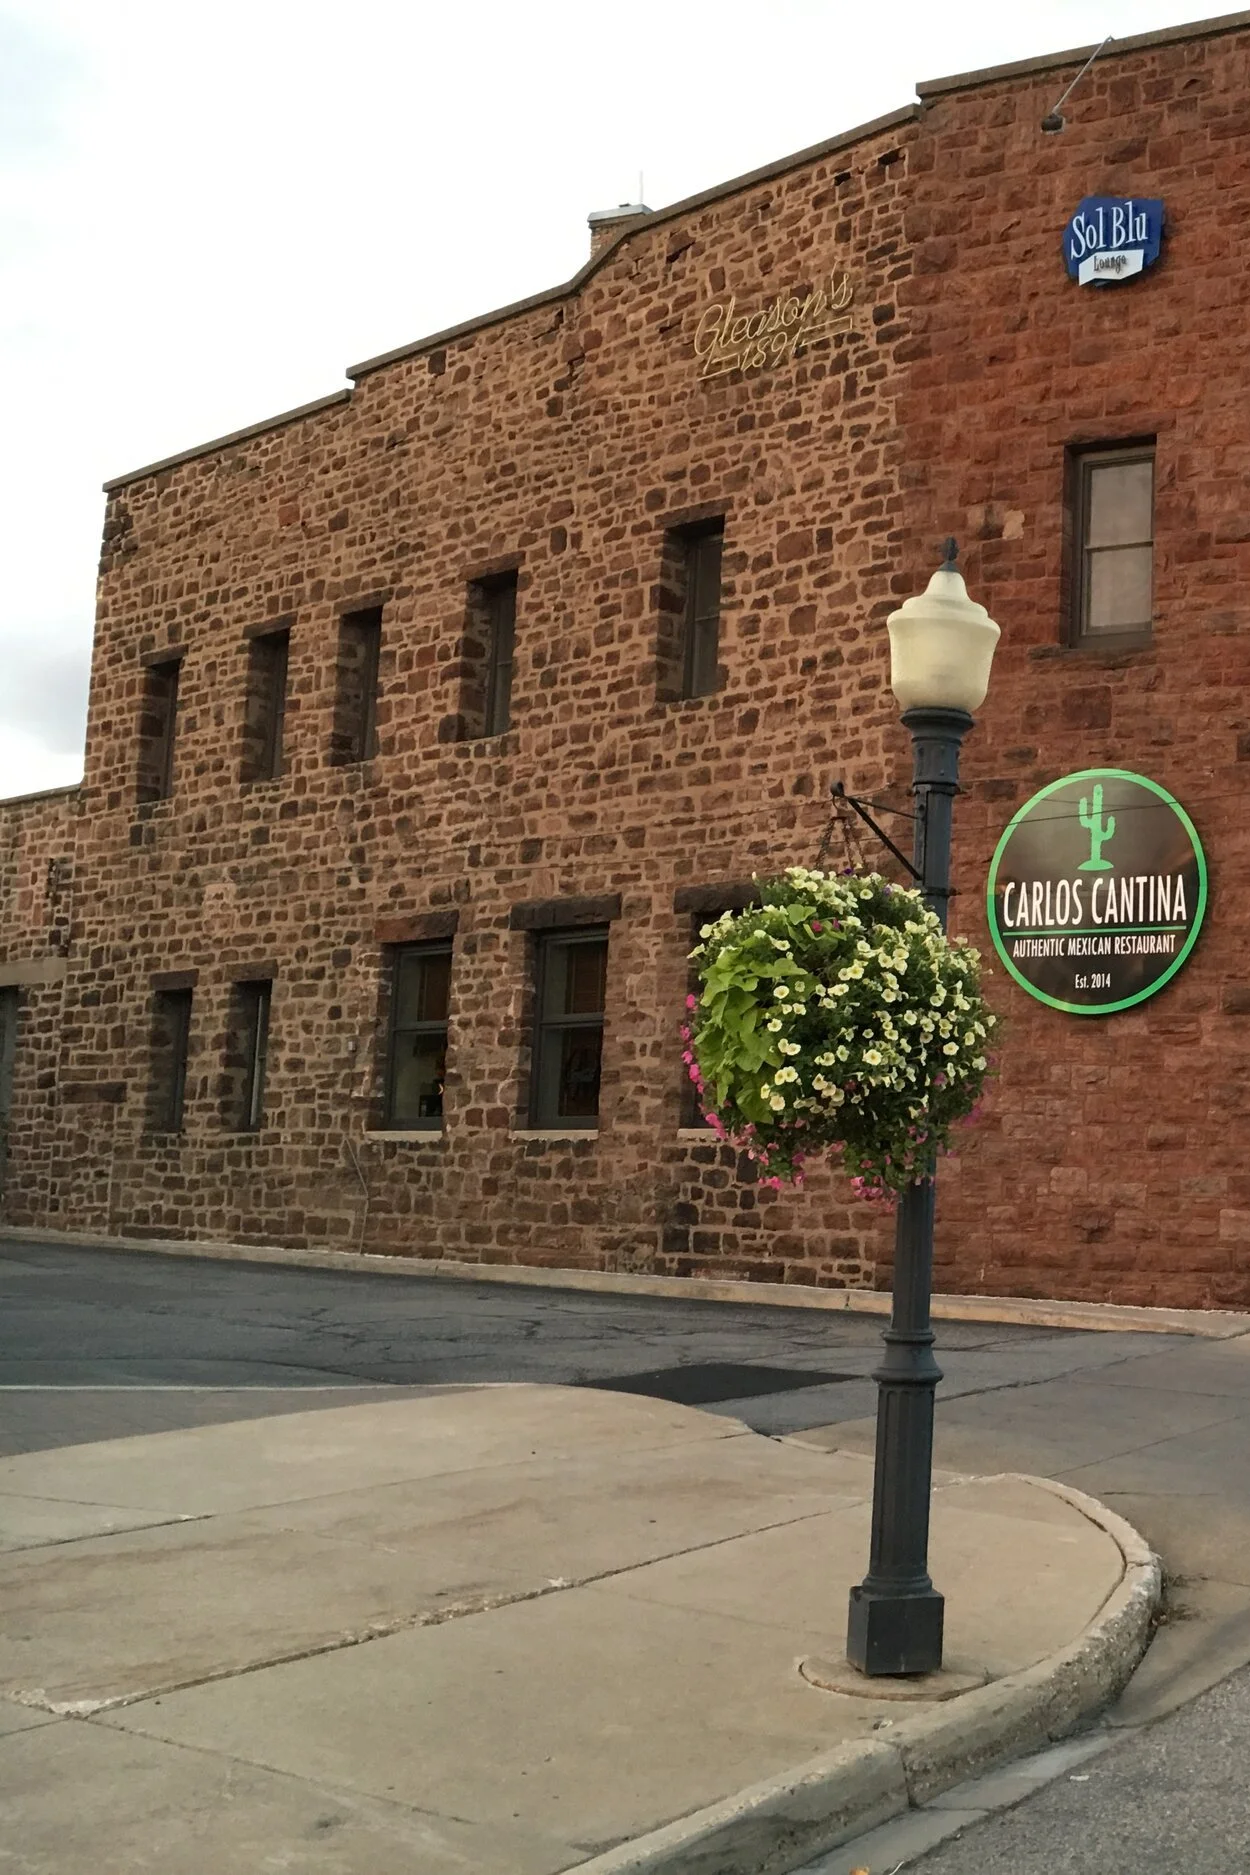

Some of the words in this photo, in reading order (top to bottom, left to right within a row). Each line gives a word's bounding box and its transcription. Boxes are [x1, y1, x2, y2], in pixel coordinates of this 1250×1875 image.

[1071, 206, 1106, 260] Sol
[1110, 201, 1148, 248] Blu
[1093, 255, 1127, 274] Lounge
[694, 256, 853, 374] Gleason's
[740, 327, 803, 373] 1891
[1003, 879, 1083, 927] CARLOS
[1091, 874, 1187, 924] CANTINA
[1013, 938, 1065, 958] AUTHENTIC
[1067, 936, 1111, 957] MEXICAN
[1114, 934, 1176, 955] RESTAURANT
[1075, 973, 1089, 989] Est.
[1091, 972, 1111, 988] 2014
